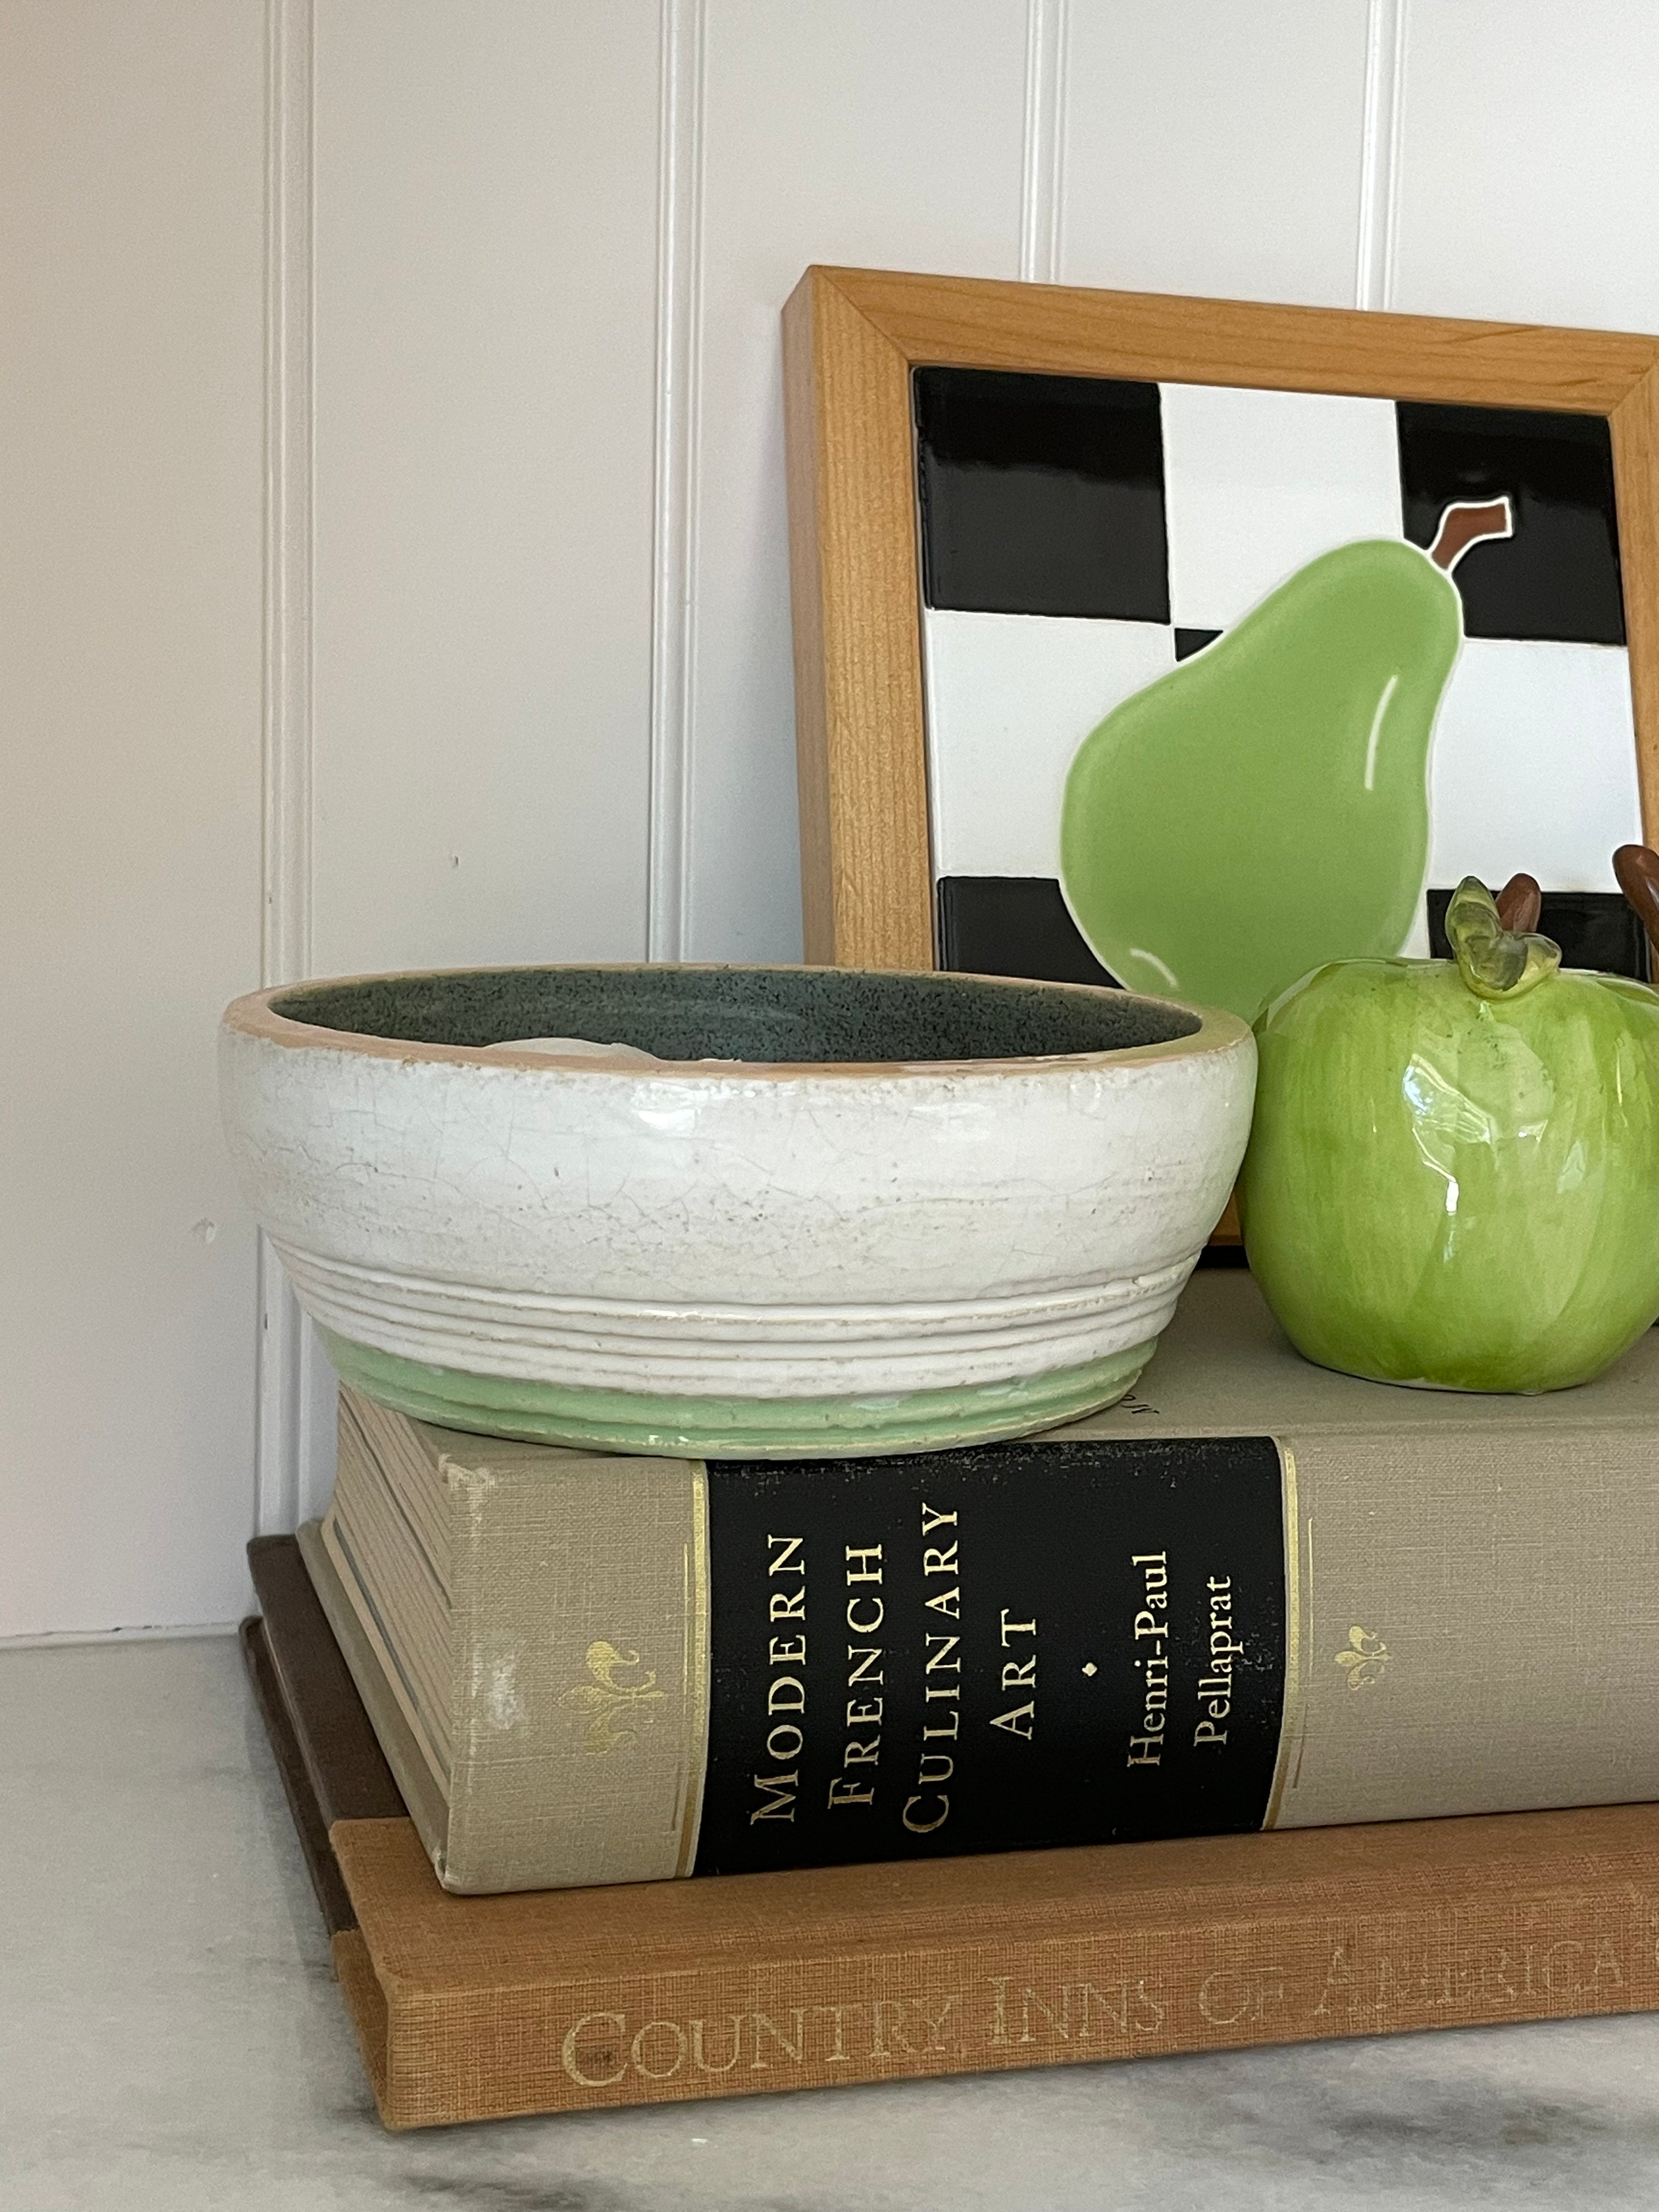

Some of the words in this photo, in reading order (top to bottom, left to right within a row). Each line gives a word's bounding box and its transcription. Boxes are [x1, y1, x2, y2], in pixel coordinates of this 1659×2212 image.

[750, 1534, 806, 1825] MODERN
[828, 1543, 884, 1810] FRENCH
[902, 1502, 961, 1833] CULINARY
[989, 1608, 1036, 1741] ART
[1127, 1550, 1167, 1768] Henri-Paul
[1193, 1575, 1244, 1747] Pellaprat
[561, 1994, 960, 2087] COUNTRY
[987, 1976, 1165, 2045] INNS
[1198, 1965, 1286, 2025] OF
